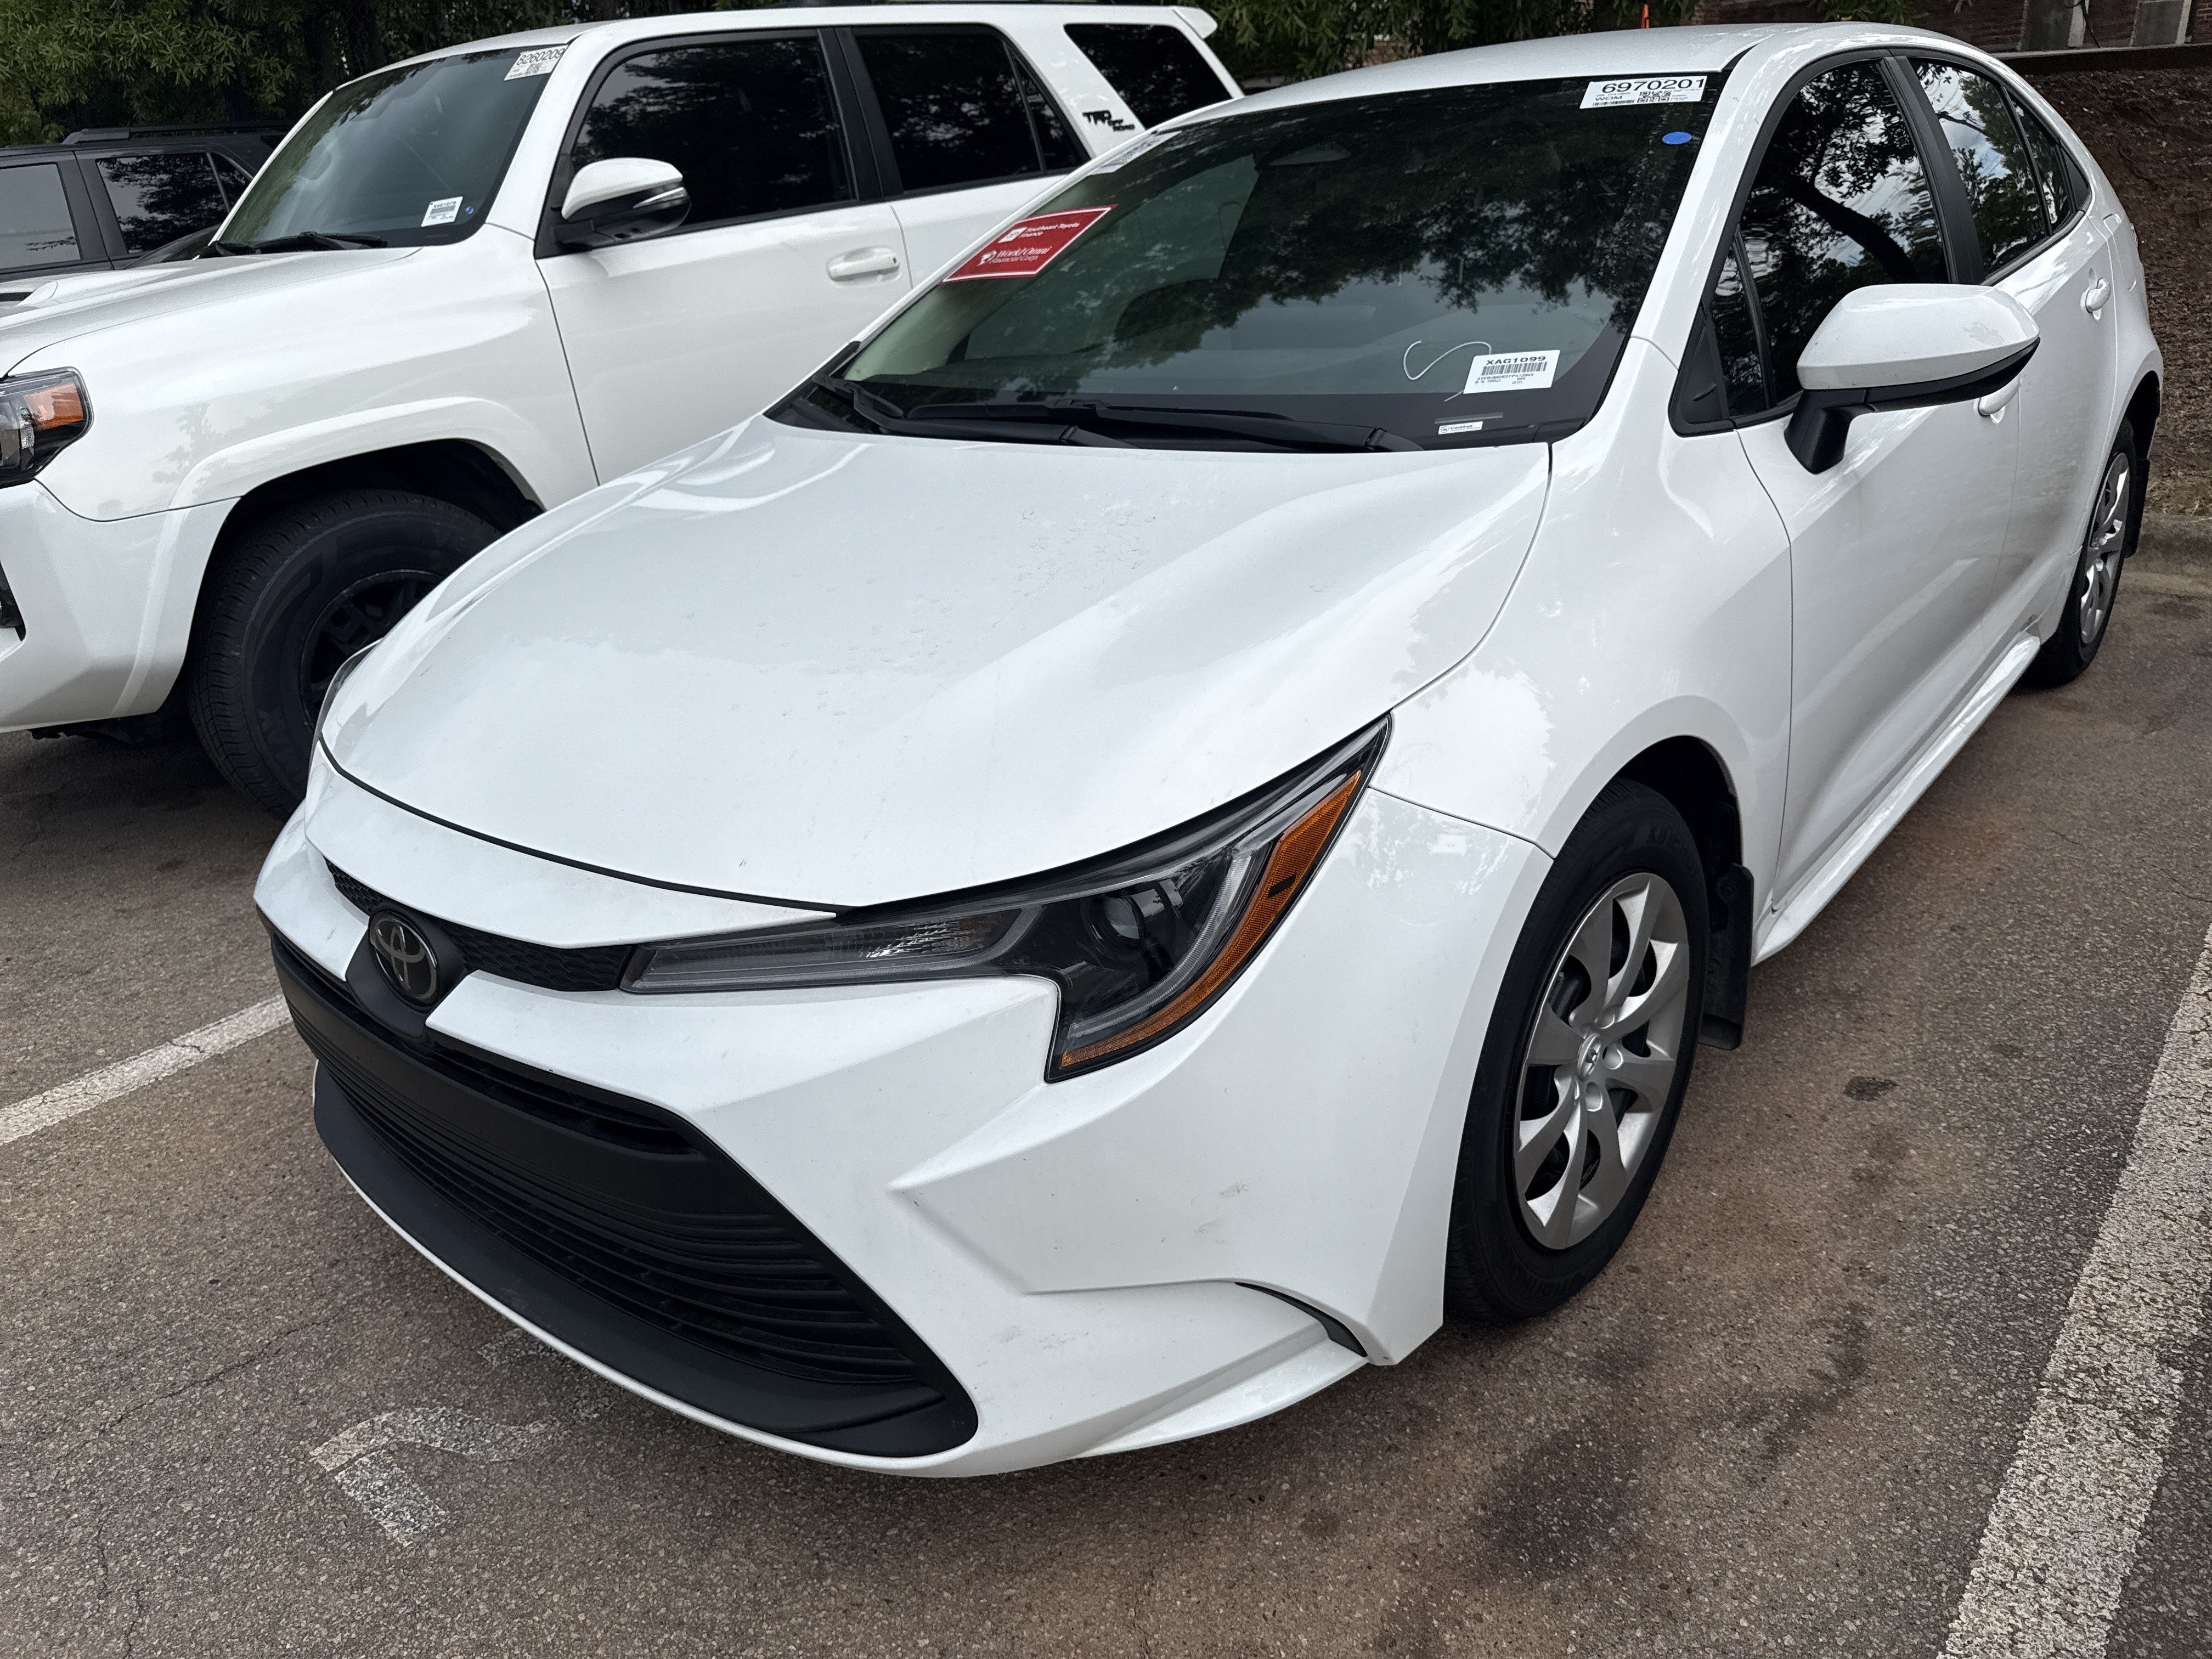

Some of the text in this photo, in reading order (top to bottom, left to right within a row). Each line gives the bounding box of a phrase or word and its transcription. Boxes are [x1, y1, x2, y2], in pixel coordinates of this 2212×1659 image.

[1601, 78, 1705, 93] 6970201
[996, 247, 1027, 258] World
[1486, 356, 1546, 365] XAG1099
